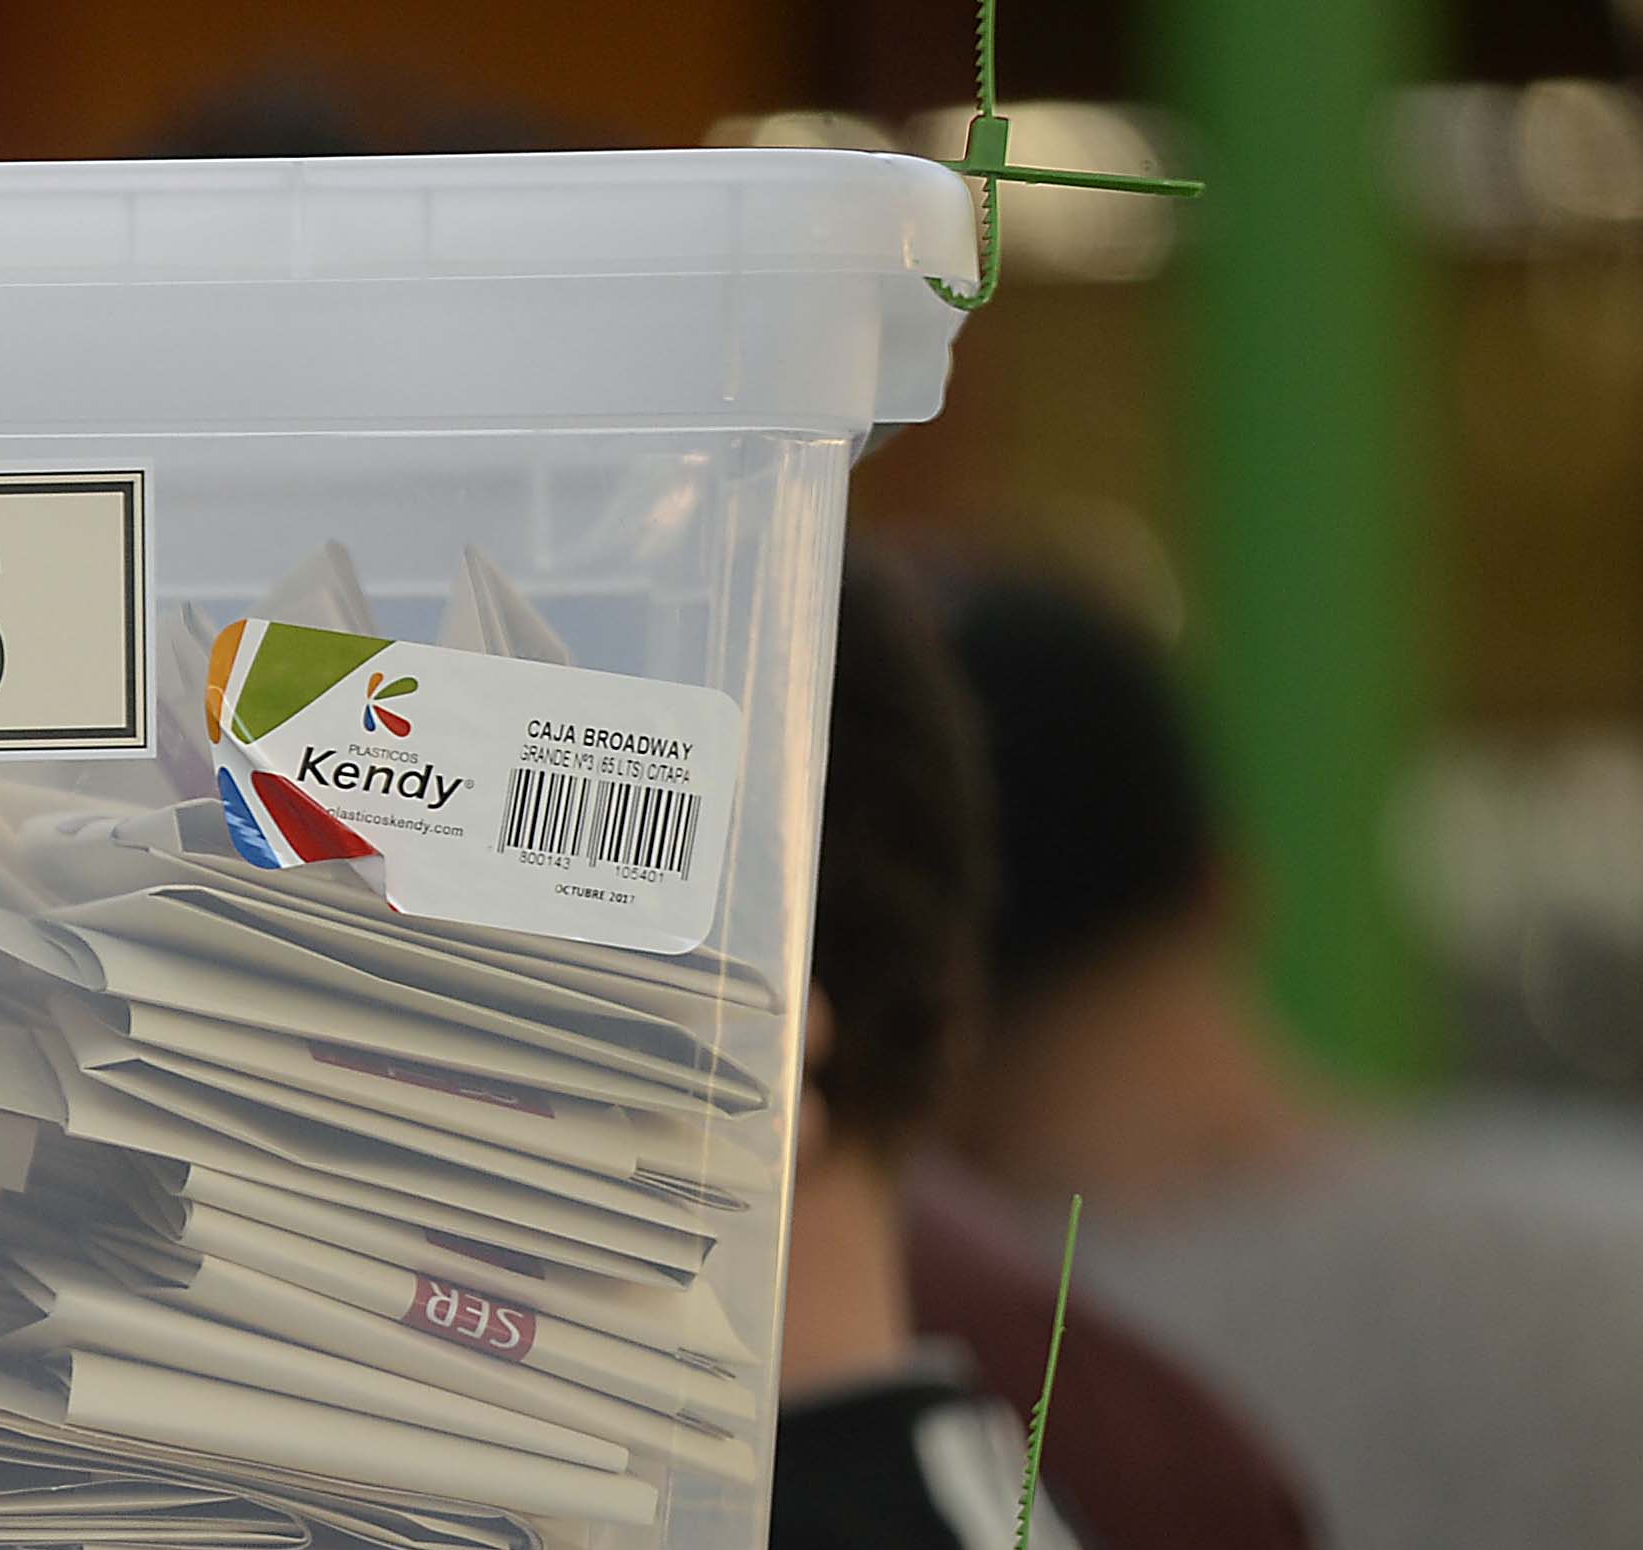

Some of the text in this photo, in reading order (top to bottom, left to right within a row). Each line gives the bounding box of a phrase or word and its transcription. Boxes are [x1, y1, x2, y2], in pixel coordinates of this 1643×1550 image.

[348, 744, 419, 764] PLASTICOS
[520, 744, 571, 768] GRANDE
[528, 720, 693, 760] CAJA BROADWAY
[297, 746, 464, 809] Kendy
[518, 850, 665, 884] 800143 105401
[555, 884, 636, 904] OCTUBRE 2017
[424, 1281, 524, 1349] SER
